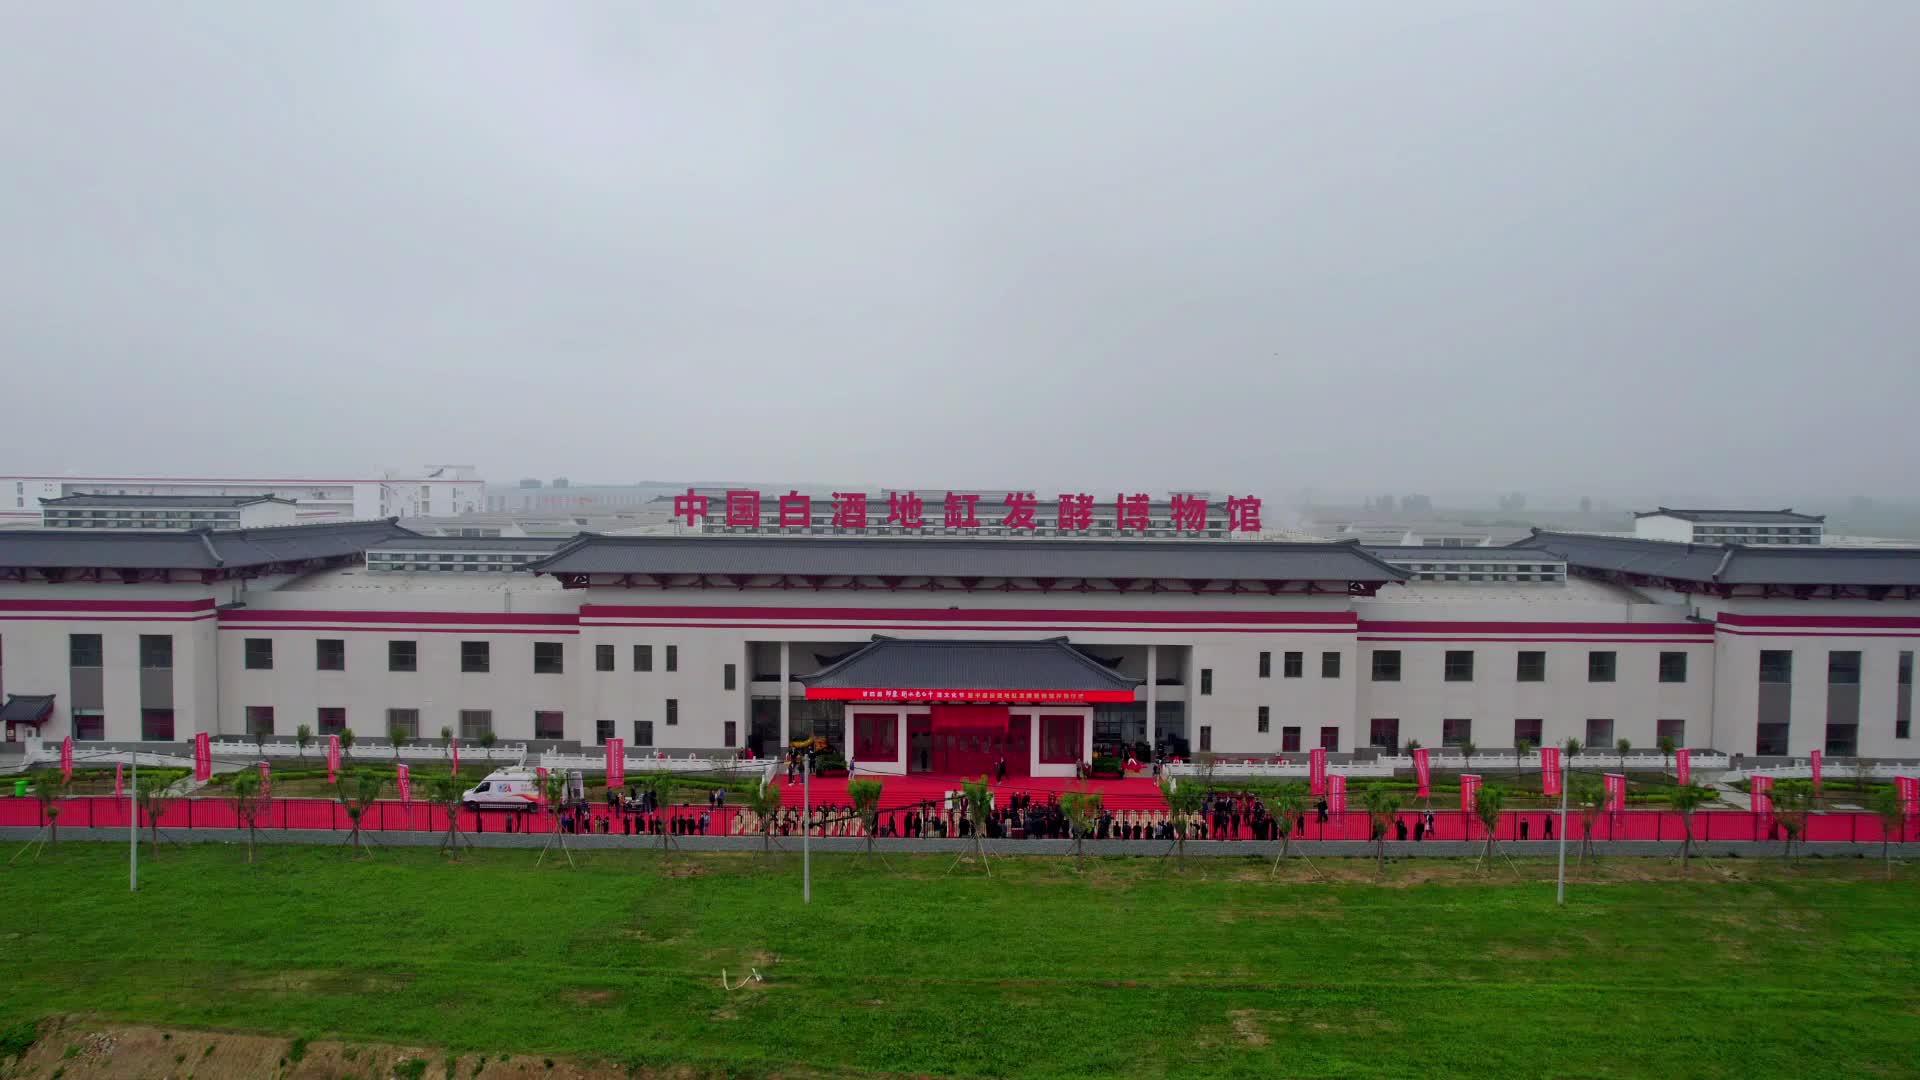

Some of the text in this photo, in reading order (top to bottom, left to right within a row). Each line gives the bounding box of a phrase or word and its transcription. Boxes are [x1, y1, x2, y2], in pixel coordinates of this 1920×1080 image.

[674, 488, 1262, 532] 中国白酒地缸发酵博物馆
